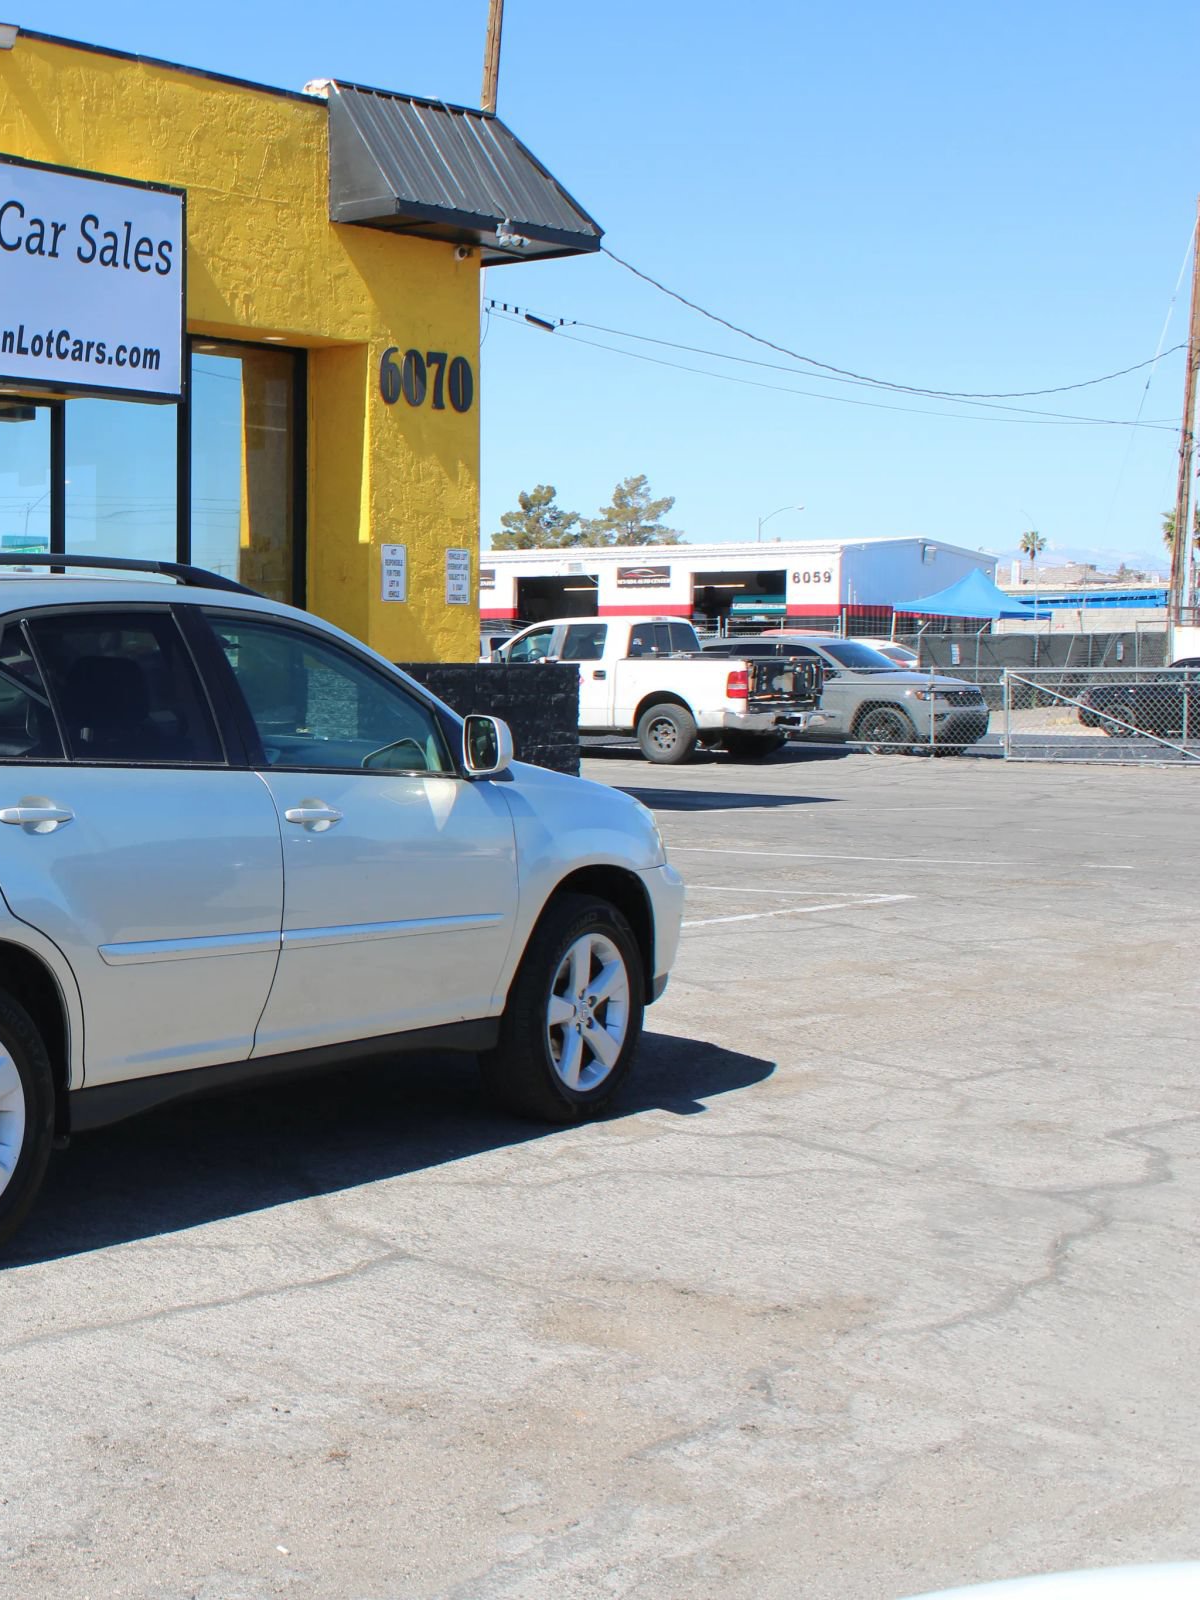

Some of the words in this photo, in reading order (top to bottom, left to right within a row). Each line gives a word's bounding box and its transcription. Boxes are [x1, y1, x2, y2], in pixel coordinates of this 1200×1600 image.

[77, 214, 173, 275] Sales
[380, 347, 474, 413] 6070
[792, 571, 832, 584] 6059
